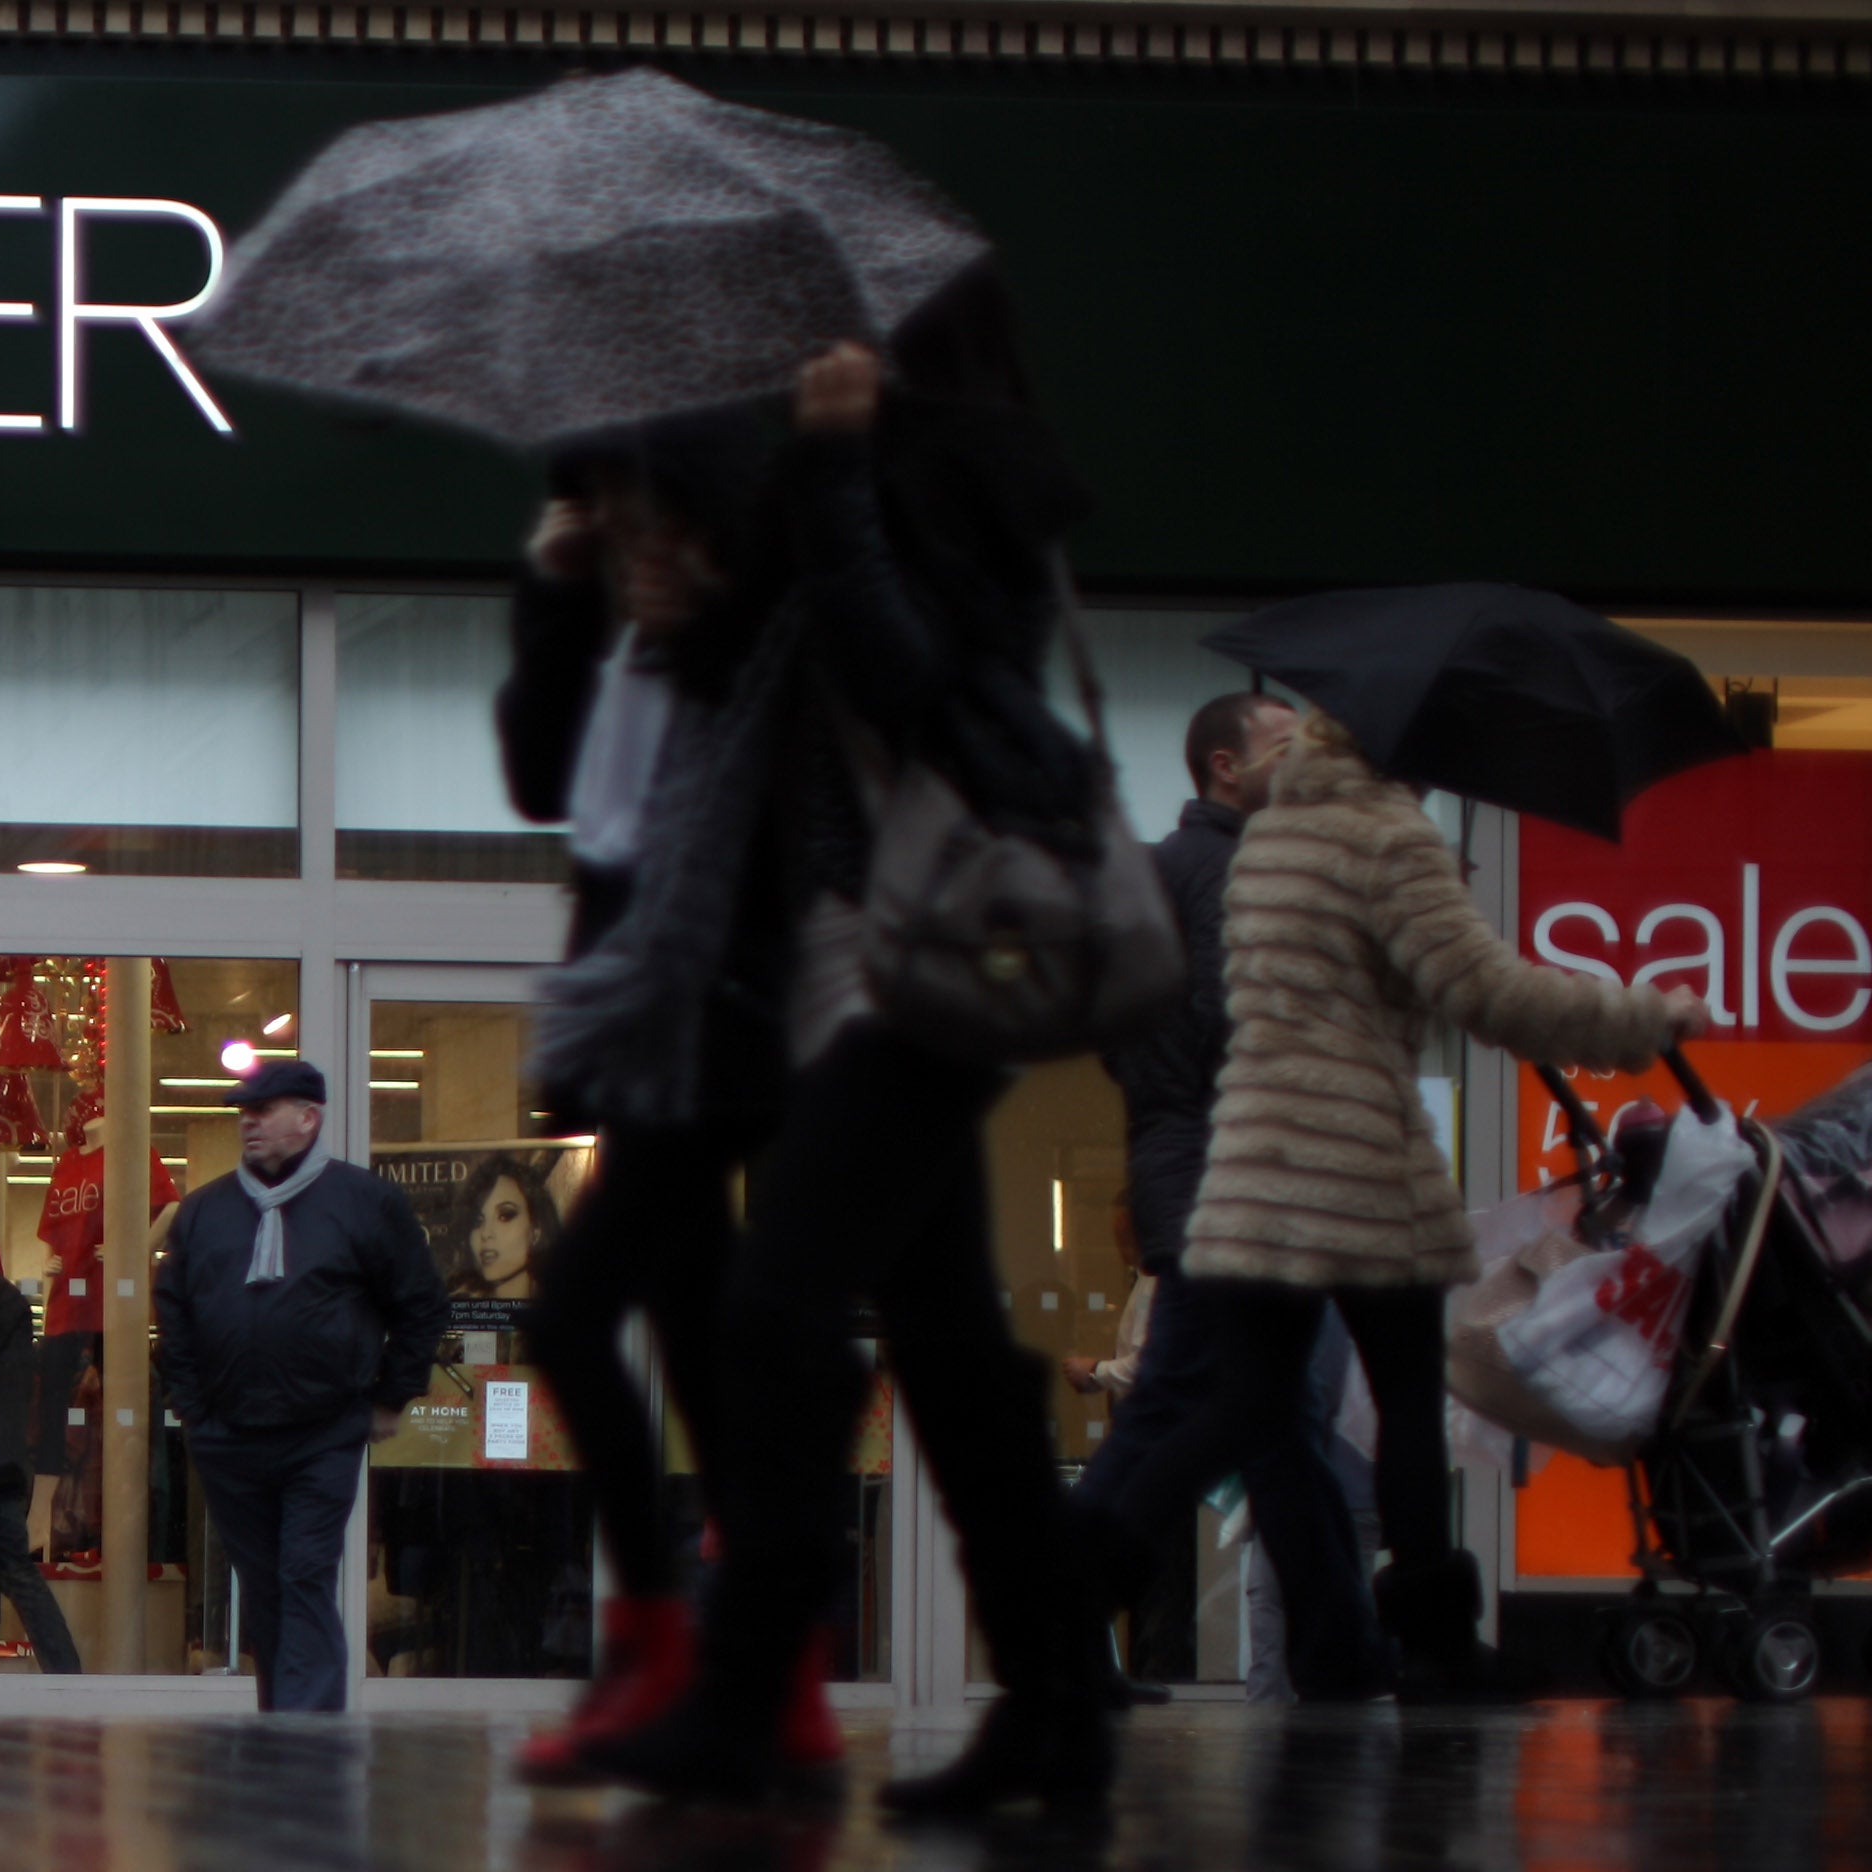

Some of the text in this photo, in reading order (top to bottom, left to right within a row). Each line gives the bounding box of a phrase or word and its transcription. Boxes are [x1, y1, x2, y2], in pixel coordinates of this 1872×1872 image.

[1533, 863, 1872, 1032] sale
[378, 1160, 468, 1184] IMITED
[493, 1387, 521, 1397] FREE
[410, 1406, 468, 1417] AT HOME
